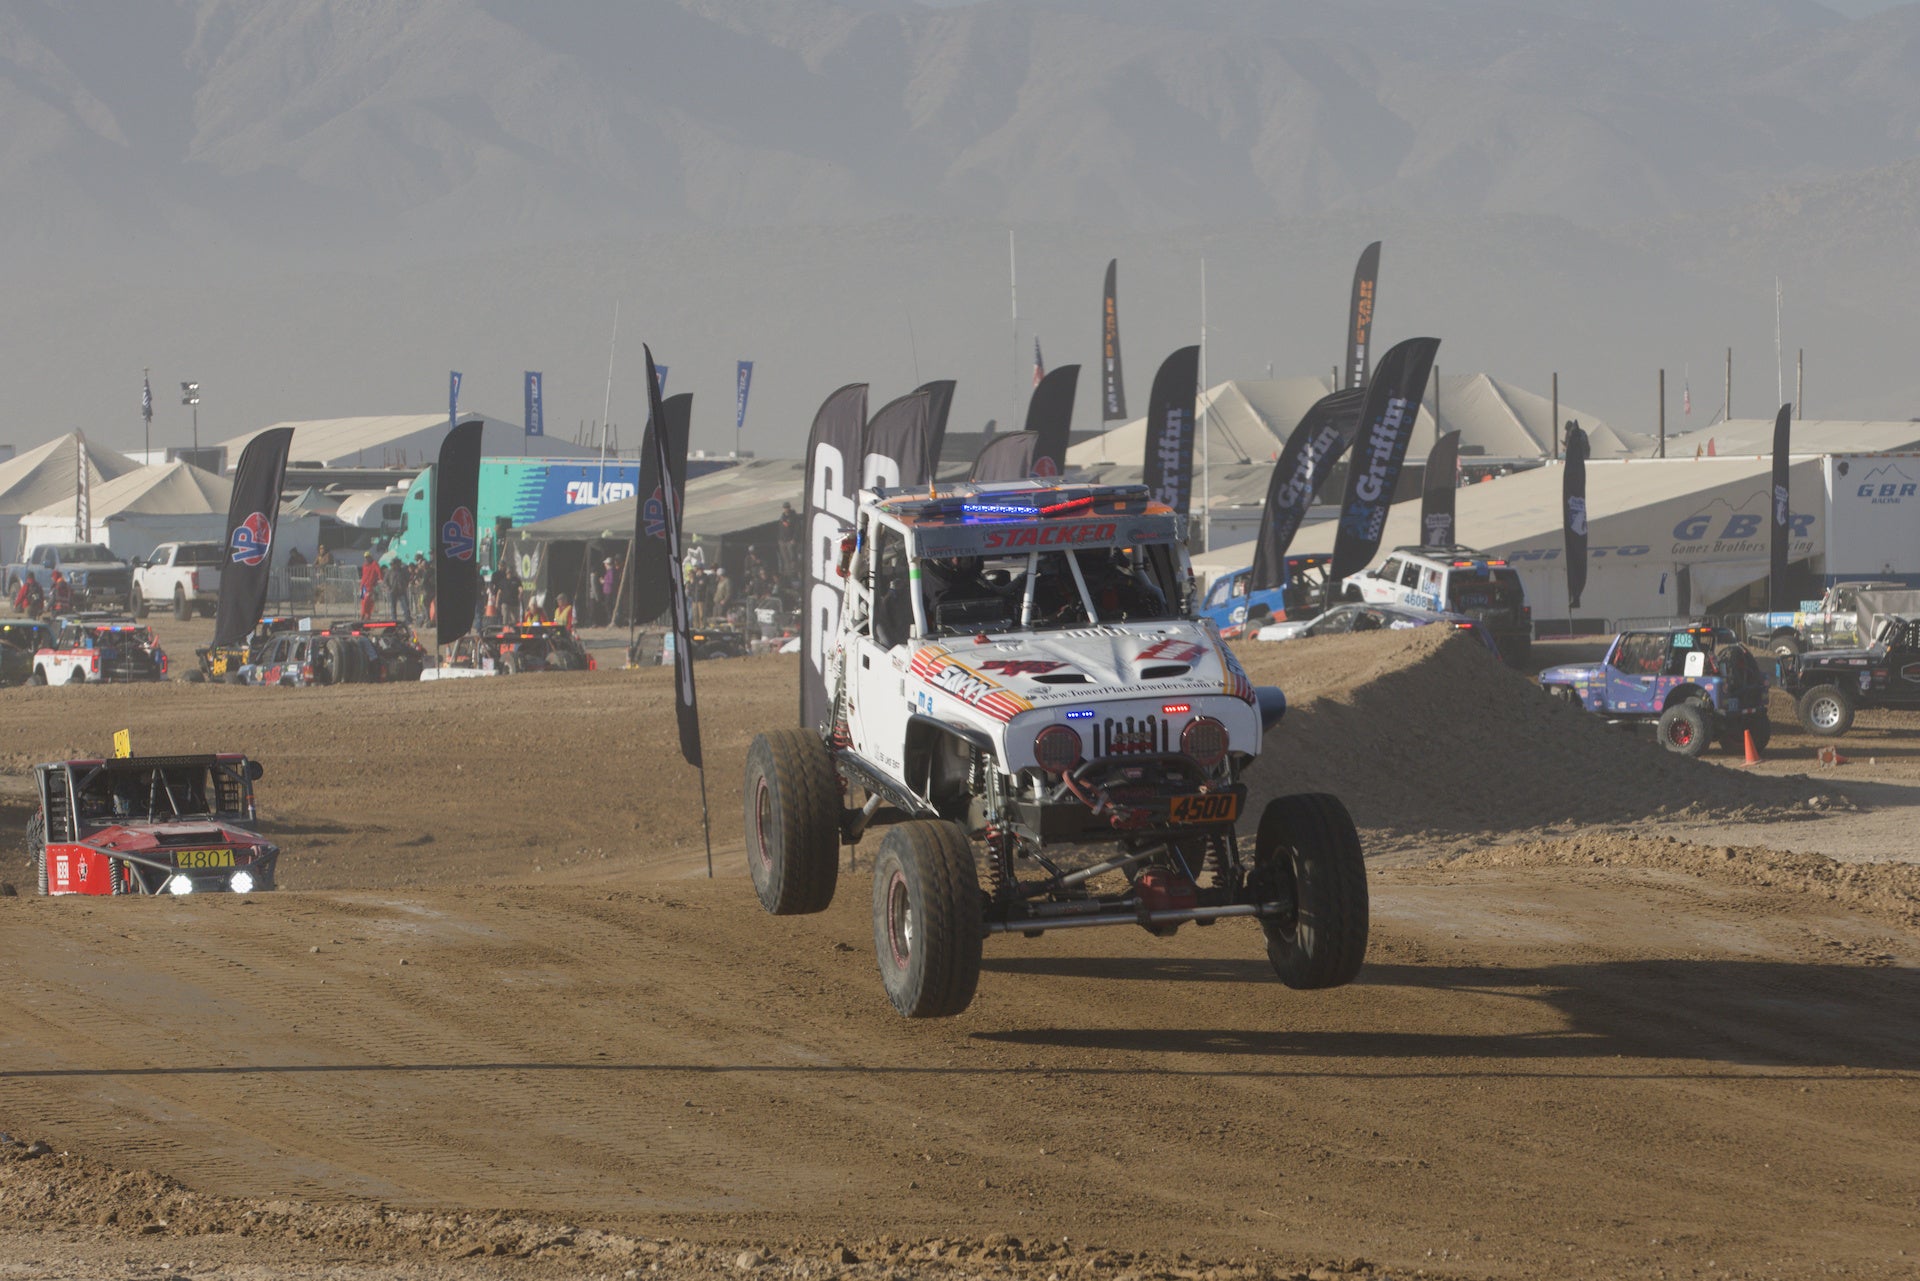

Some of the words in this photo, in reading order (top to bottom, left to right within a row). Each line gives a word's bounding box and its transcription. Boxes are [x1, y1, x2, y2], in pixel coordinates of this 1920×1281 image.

[1150, 408, 1182, 508] Griffin
[1356, 397, 1406, 502] Griffin
[566, 481, 635, 505] FALKEN
[231, 525, 268, 562] VP
[442, 520, 473, 558] VP
[984, 523, 1117, 548] STACKED
[1713, 540, 1766, 553] Brothers
[1508, 545, 1651, 561] NITO
[1404, 593, 1427, 608] 4608
[1040, 680, 1211, 701] www.TowerPlaceJewelers.com
[1174, 796, 1232, 820] 4500
[180, 850, 232, 868] 4801
